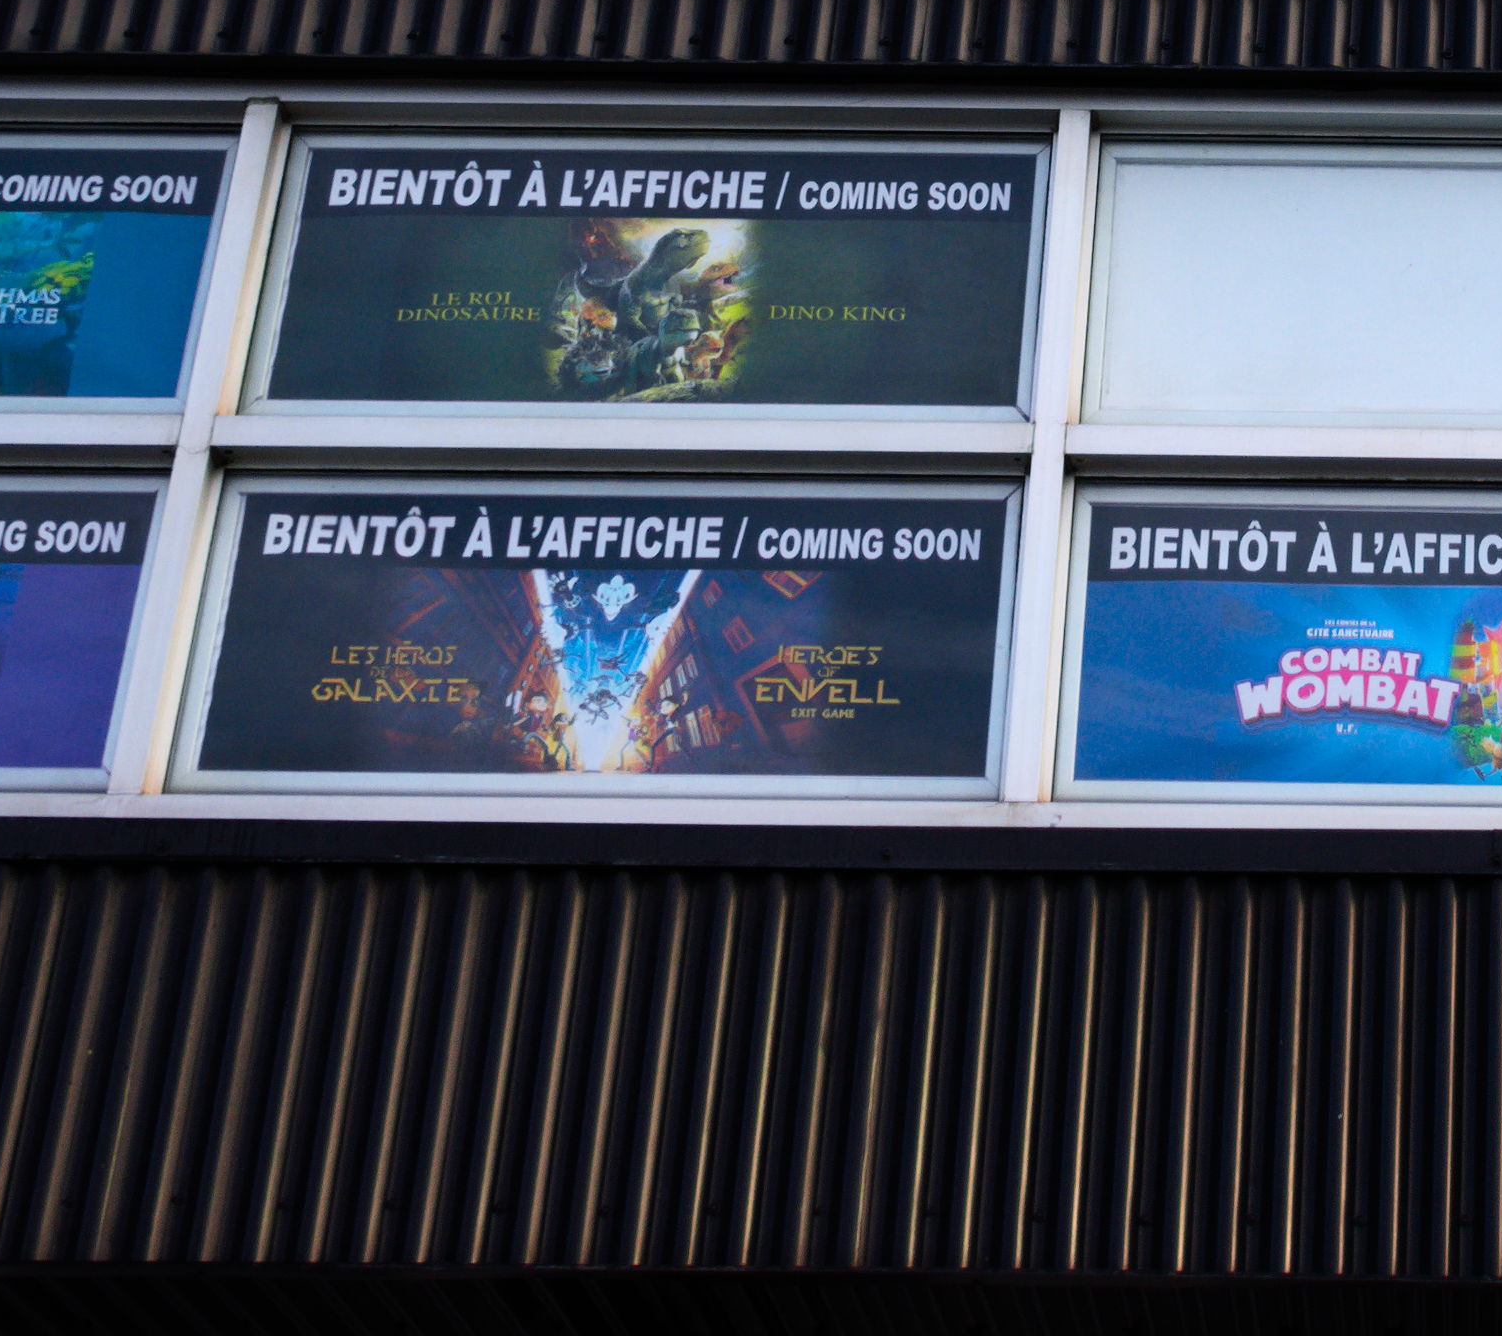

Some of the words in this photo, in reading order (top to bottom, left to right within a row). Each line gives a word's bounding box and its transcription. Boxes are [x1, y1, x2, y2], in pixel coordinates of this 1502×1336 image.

[110, 175, 198, 205] SOON
[328, 160, 511, 207] BIENTÔT
[518, 160, 547, 208] À
[559, 170, 767, 209] L'AFFICHE
[799, 180, 919, 210] COMING
[927, 181, 1012, 211] SOON
[431, 292, 461, 306] LE
[469, 291, 511, 306] ROI
[397, 307, 541, 322] DINOSAURE
[769, 304, 835, 321] DINO
[841, 306, 907, 322] KING
[34, 520, 126, 553] SOON
[262, 505, 456, 558] BIENTÔT
[462, 506, 493, 558] À
[507, 516, 724, 559] L'AFFICHE
[757, 527, 883, 560] COMING
[893, 528, 982, 561] SOON
[1109, 520, 1297, 572] BIENTÔT
[1307, 521, 1338, 573] À
[331, 646, 379, 665] LES
[777, 645, 883, 666] HEROES
[1279, 647, 1422, 677] COMBAT
[311, 678, 469, 703] GALAXIE
[754, 677, 901, 704] ENVELL
[1235, 675, 1460, 726] WOMBAT
[791, 708, 816, 719] EXIT
[822, 708, 855, 720] GAME
